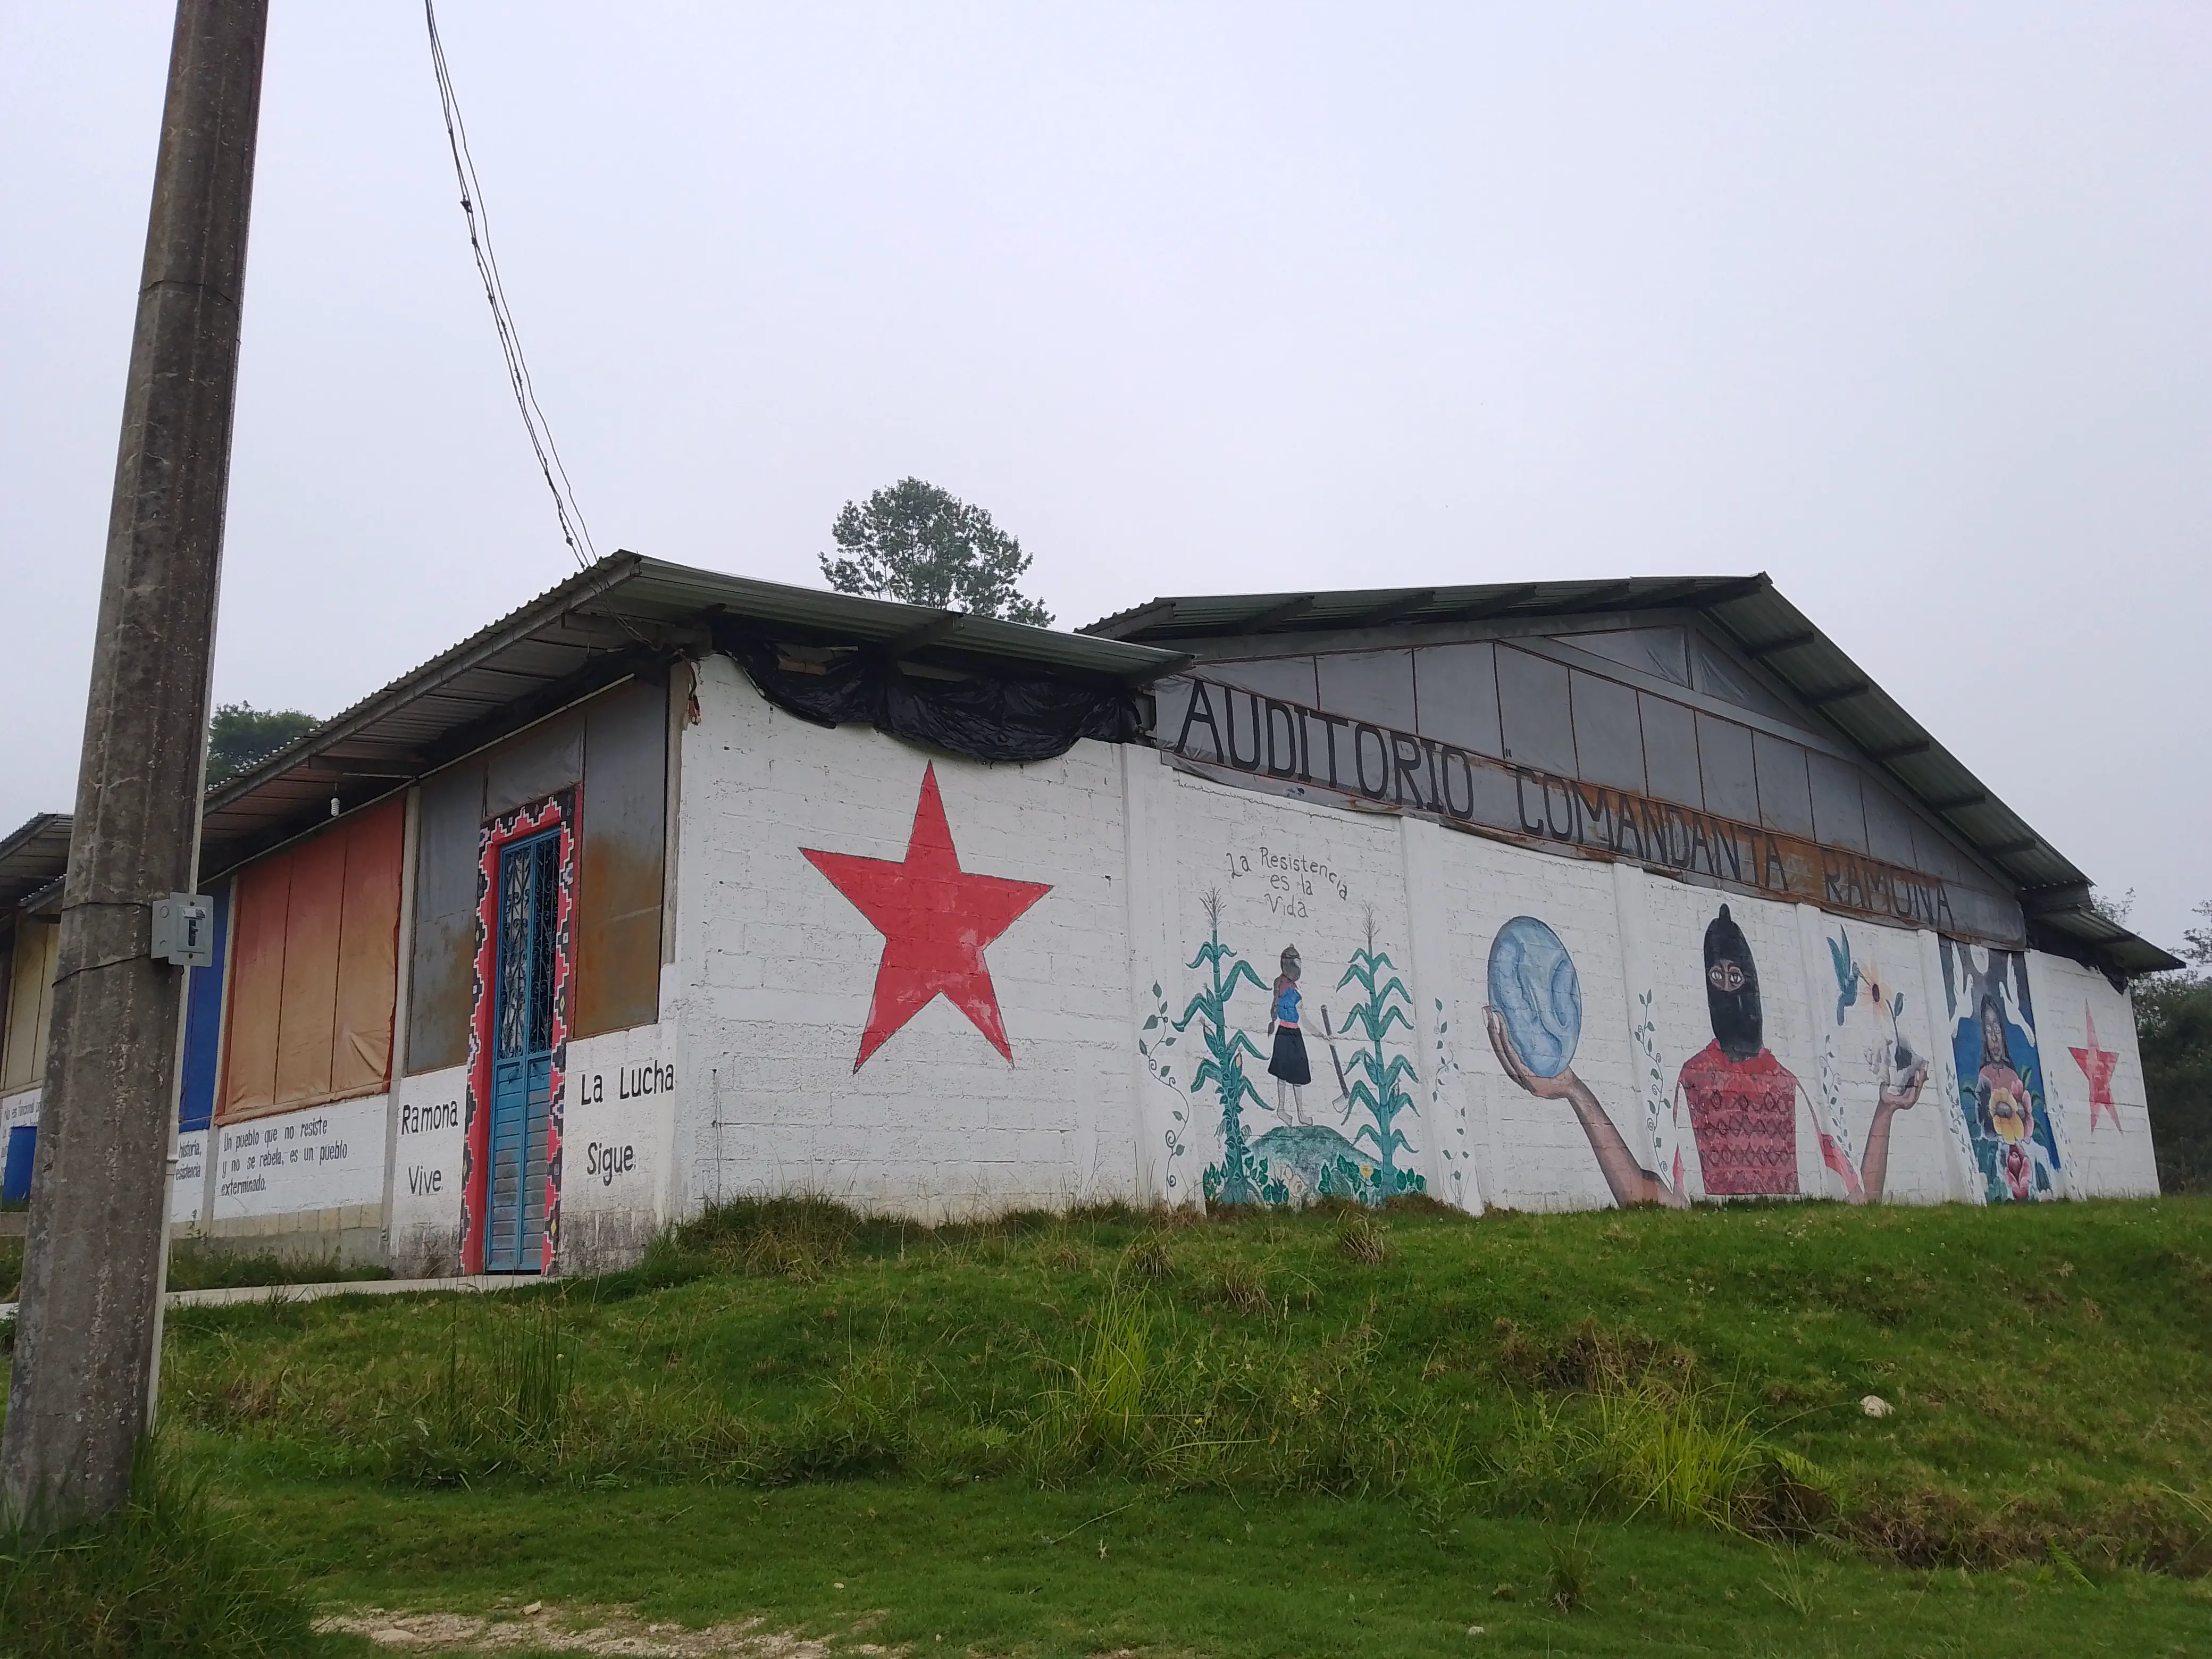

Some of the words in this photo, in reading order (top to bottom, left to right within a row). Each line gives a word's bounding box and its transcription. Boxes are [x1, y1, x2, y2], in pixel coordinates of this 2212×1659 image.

[1175, 680, 1473, 820] AUDITORIO
[1821, 849, 1955, 930] RAMONA
[1226, 852, 1252, 879] La
[1259, 847, 1348, 901] Resistencia
[1270, 874, 1290, 891] es
[1301, 873, 1313, 895] la
[1264, 893, 1309, 918] Vida
[581, 1073, 604, 1105] La
[619, 1060, 675, 1100] Lucha
[224, 1133, 232, 1152] Un
[236, 1129, 259, 1153] pueblo
[264, 1128, 278, 1148] que
[284, 1126, 294, 1140] no
[300, 1116, 328, 1138] resiste
[401, 1100, 459, 1135] Ramona
[176, 1162, 200, 1180] esistencia
[222, 1161, 227, 1179] y
[231, 1159, 240, 1172] no
[247, 1155, 255, 1170] se
[259, 1147, 284, 1167] rebela,
[290, 1149, 298, 1163] es
[304, 1146, 313, 1161] un
[319, 1139, 347, 1167] pueblo
[221, 1173, 266, 1196] exterminado.
